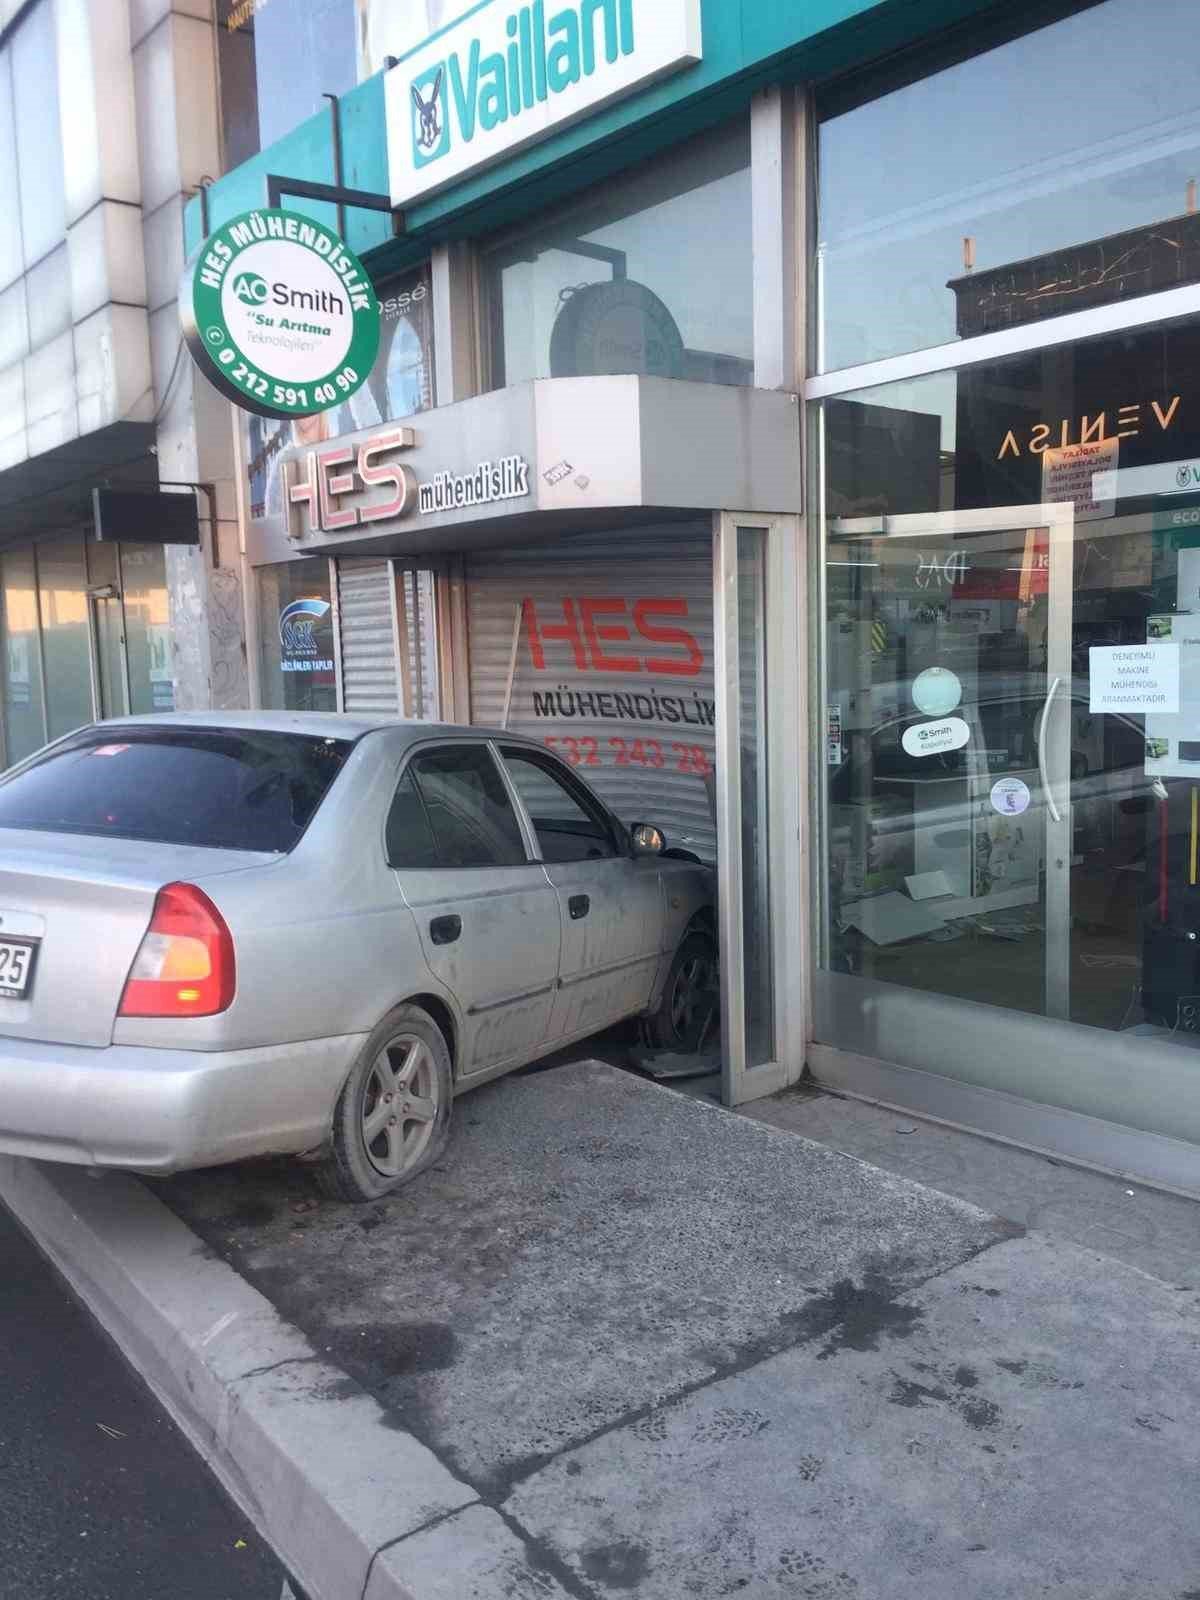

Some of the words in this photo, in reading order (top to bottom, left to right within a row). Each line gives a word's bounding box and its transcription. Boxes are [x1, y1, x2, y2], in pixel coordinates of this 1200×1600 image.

[200, 239, 234, 290] HES
[228, 212, 371, 311] MÜHENDİSLİK
[272, 282, 344, 316] Smith
[218, 348, 236, 365] 0
[231, 361, 270, 398] 212
[273, 387, 308, 408] 591
[314, 385, 337, 405] 40
[336, 366, 359, 388] 90
[283, 427, 415, 538] HES
[418, 457, 528, 513] mühendislik
[522, 595, 704, 676] HES
[607, 736, 664, 768] 243
